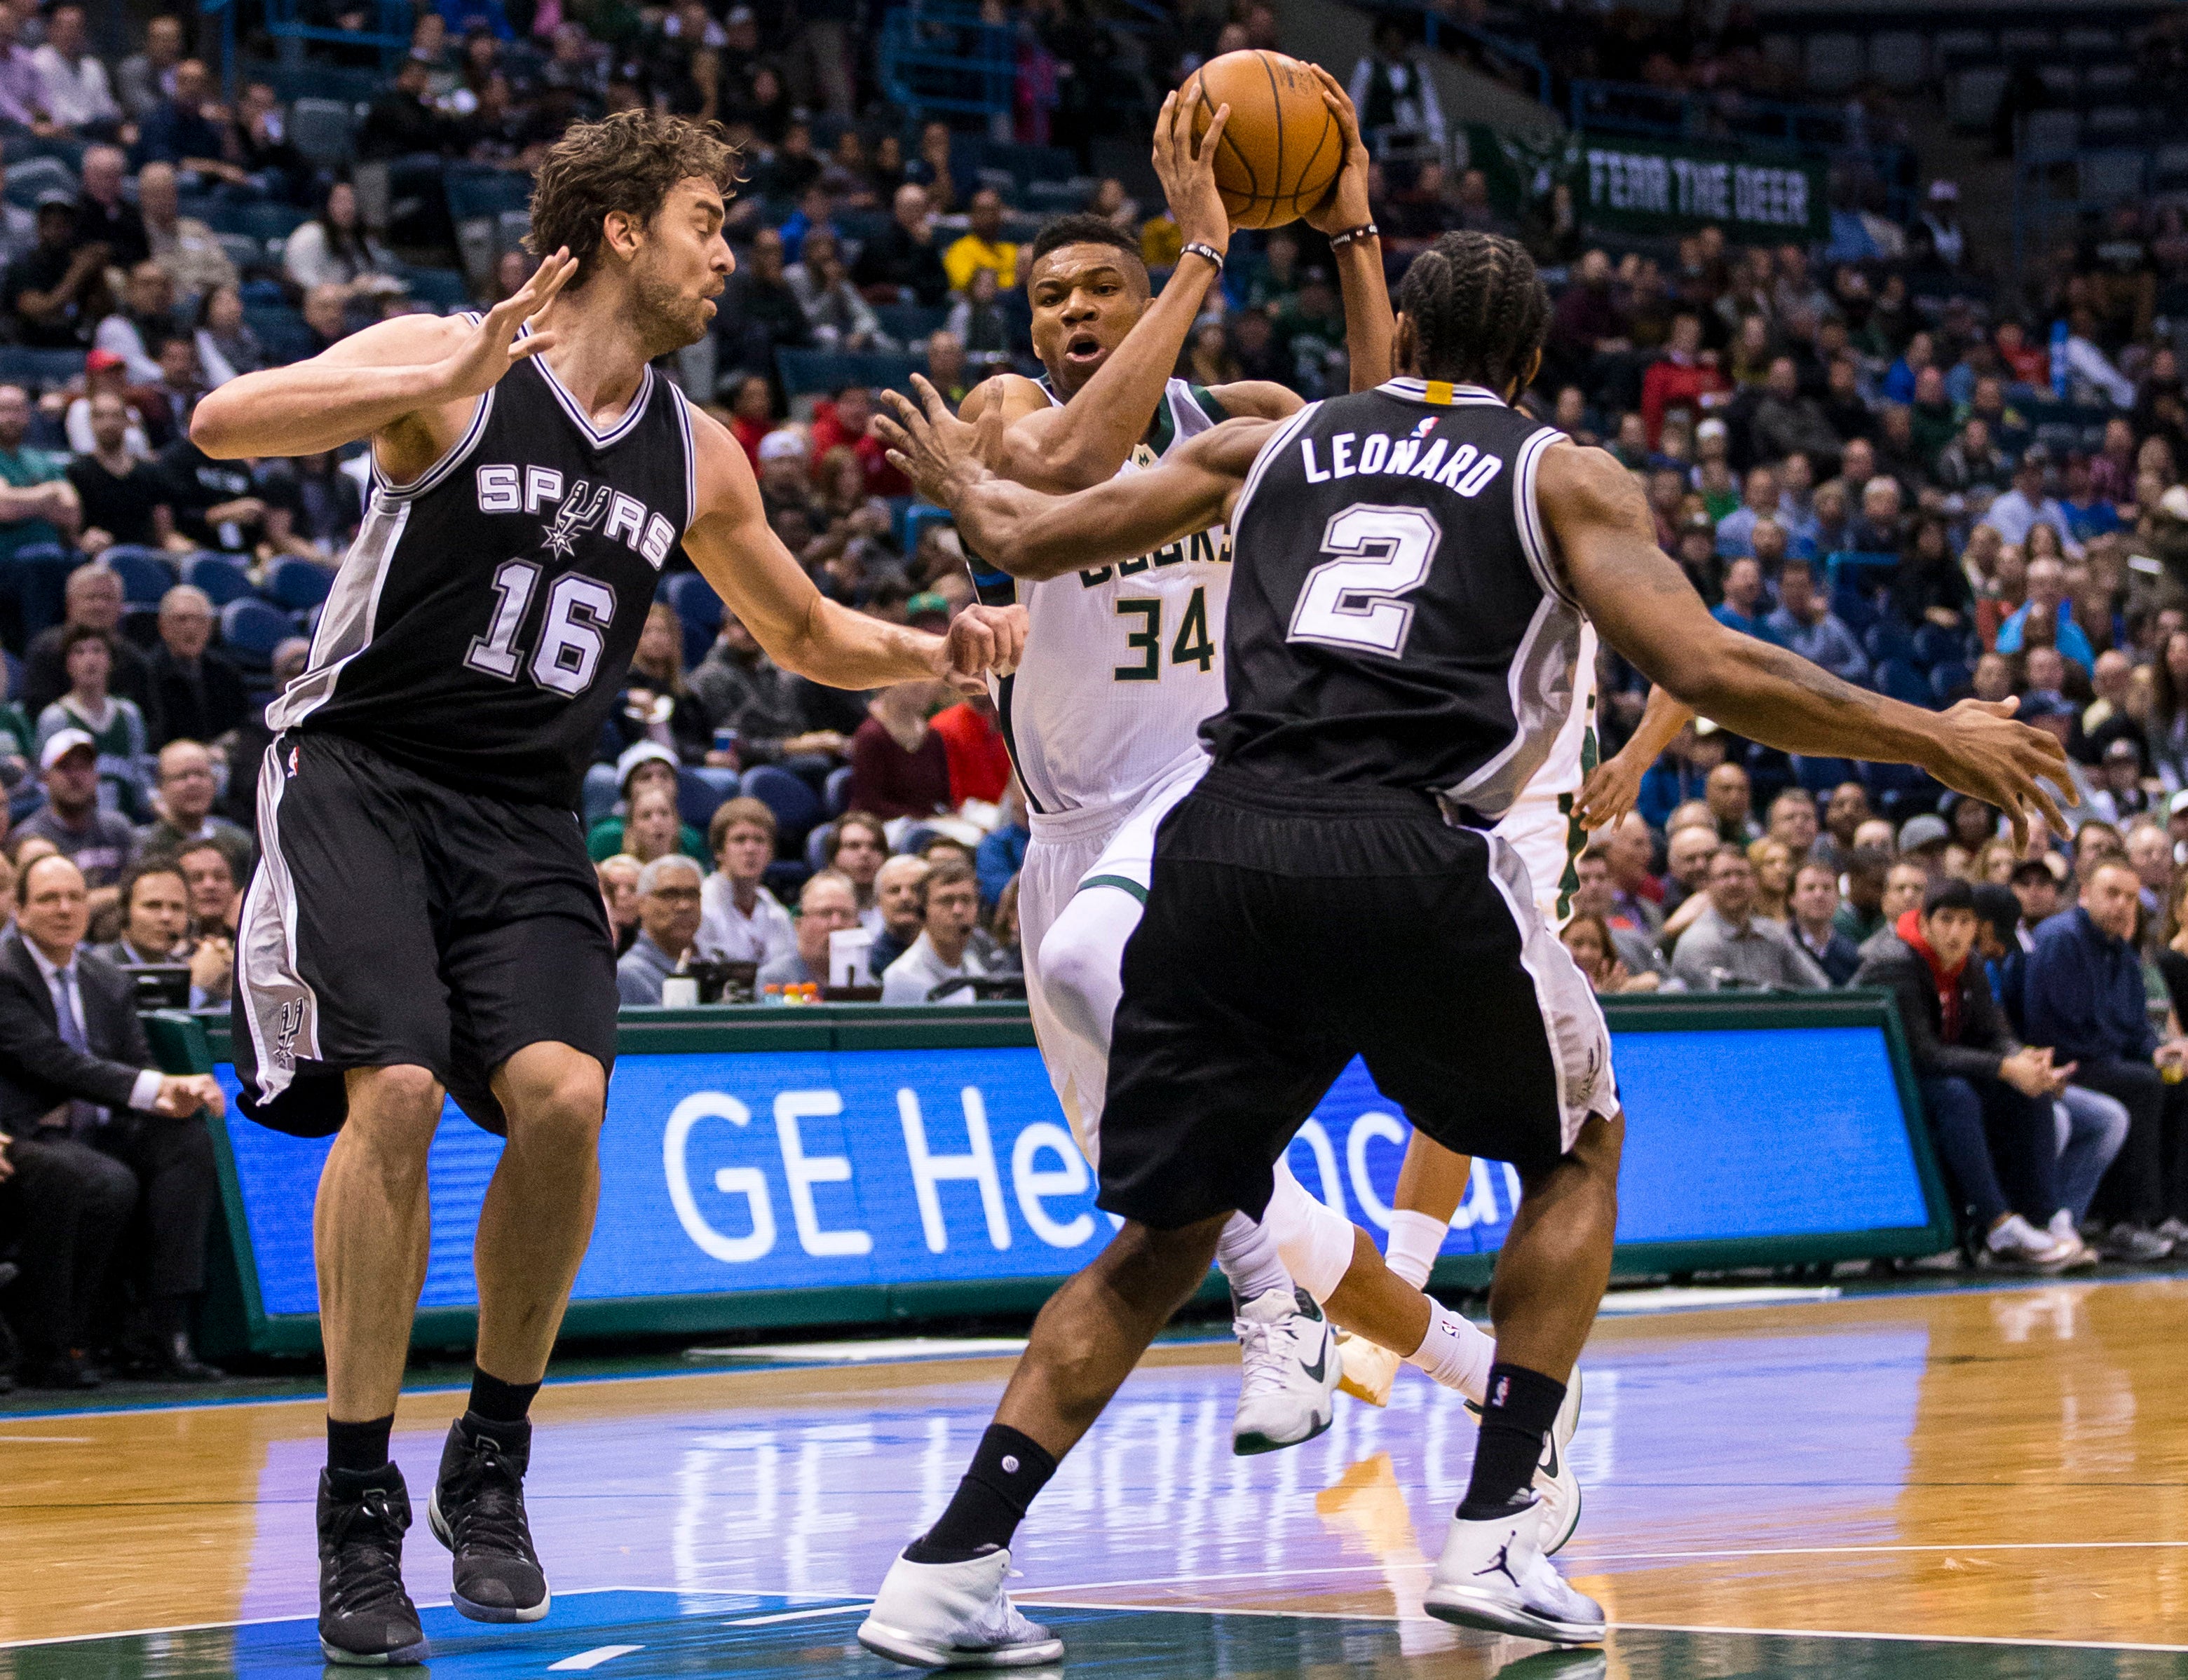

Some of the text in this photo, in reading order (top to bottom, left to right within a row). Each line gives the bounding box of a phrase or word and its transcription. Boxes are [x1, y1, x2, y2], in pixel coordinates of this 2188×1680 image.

[1672, 158, 1730, 219] THE
[1735, 165, 1809, 226] DEER
[476, 464, 676, 571] SPURS
[1301, 432, 1502, 497] LEONARD
[463, 557, 617, 699] 16
[1113, 586, 1215, 683] 34
[1285, 502, 1442, 660] 2
[663, 1091, 874, 1262] GE
